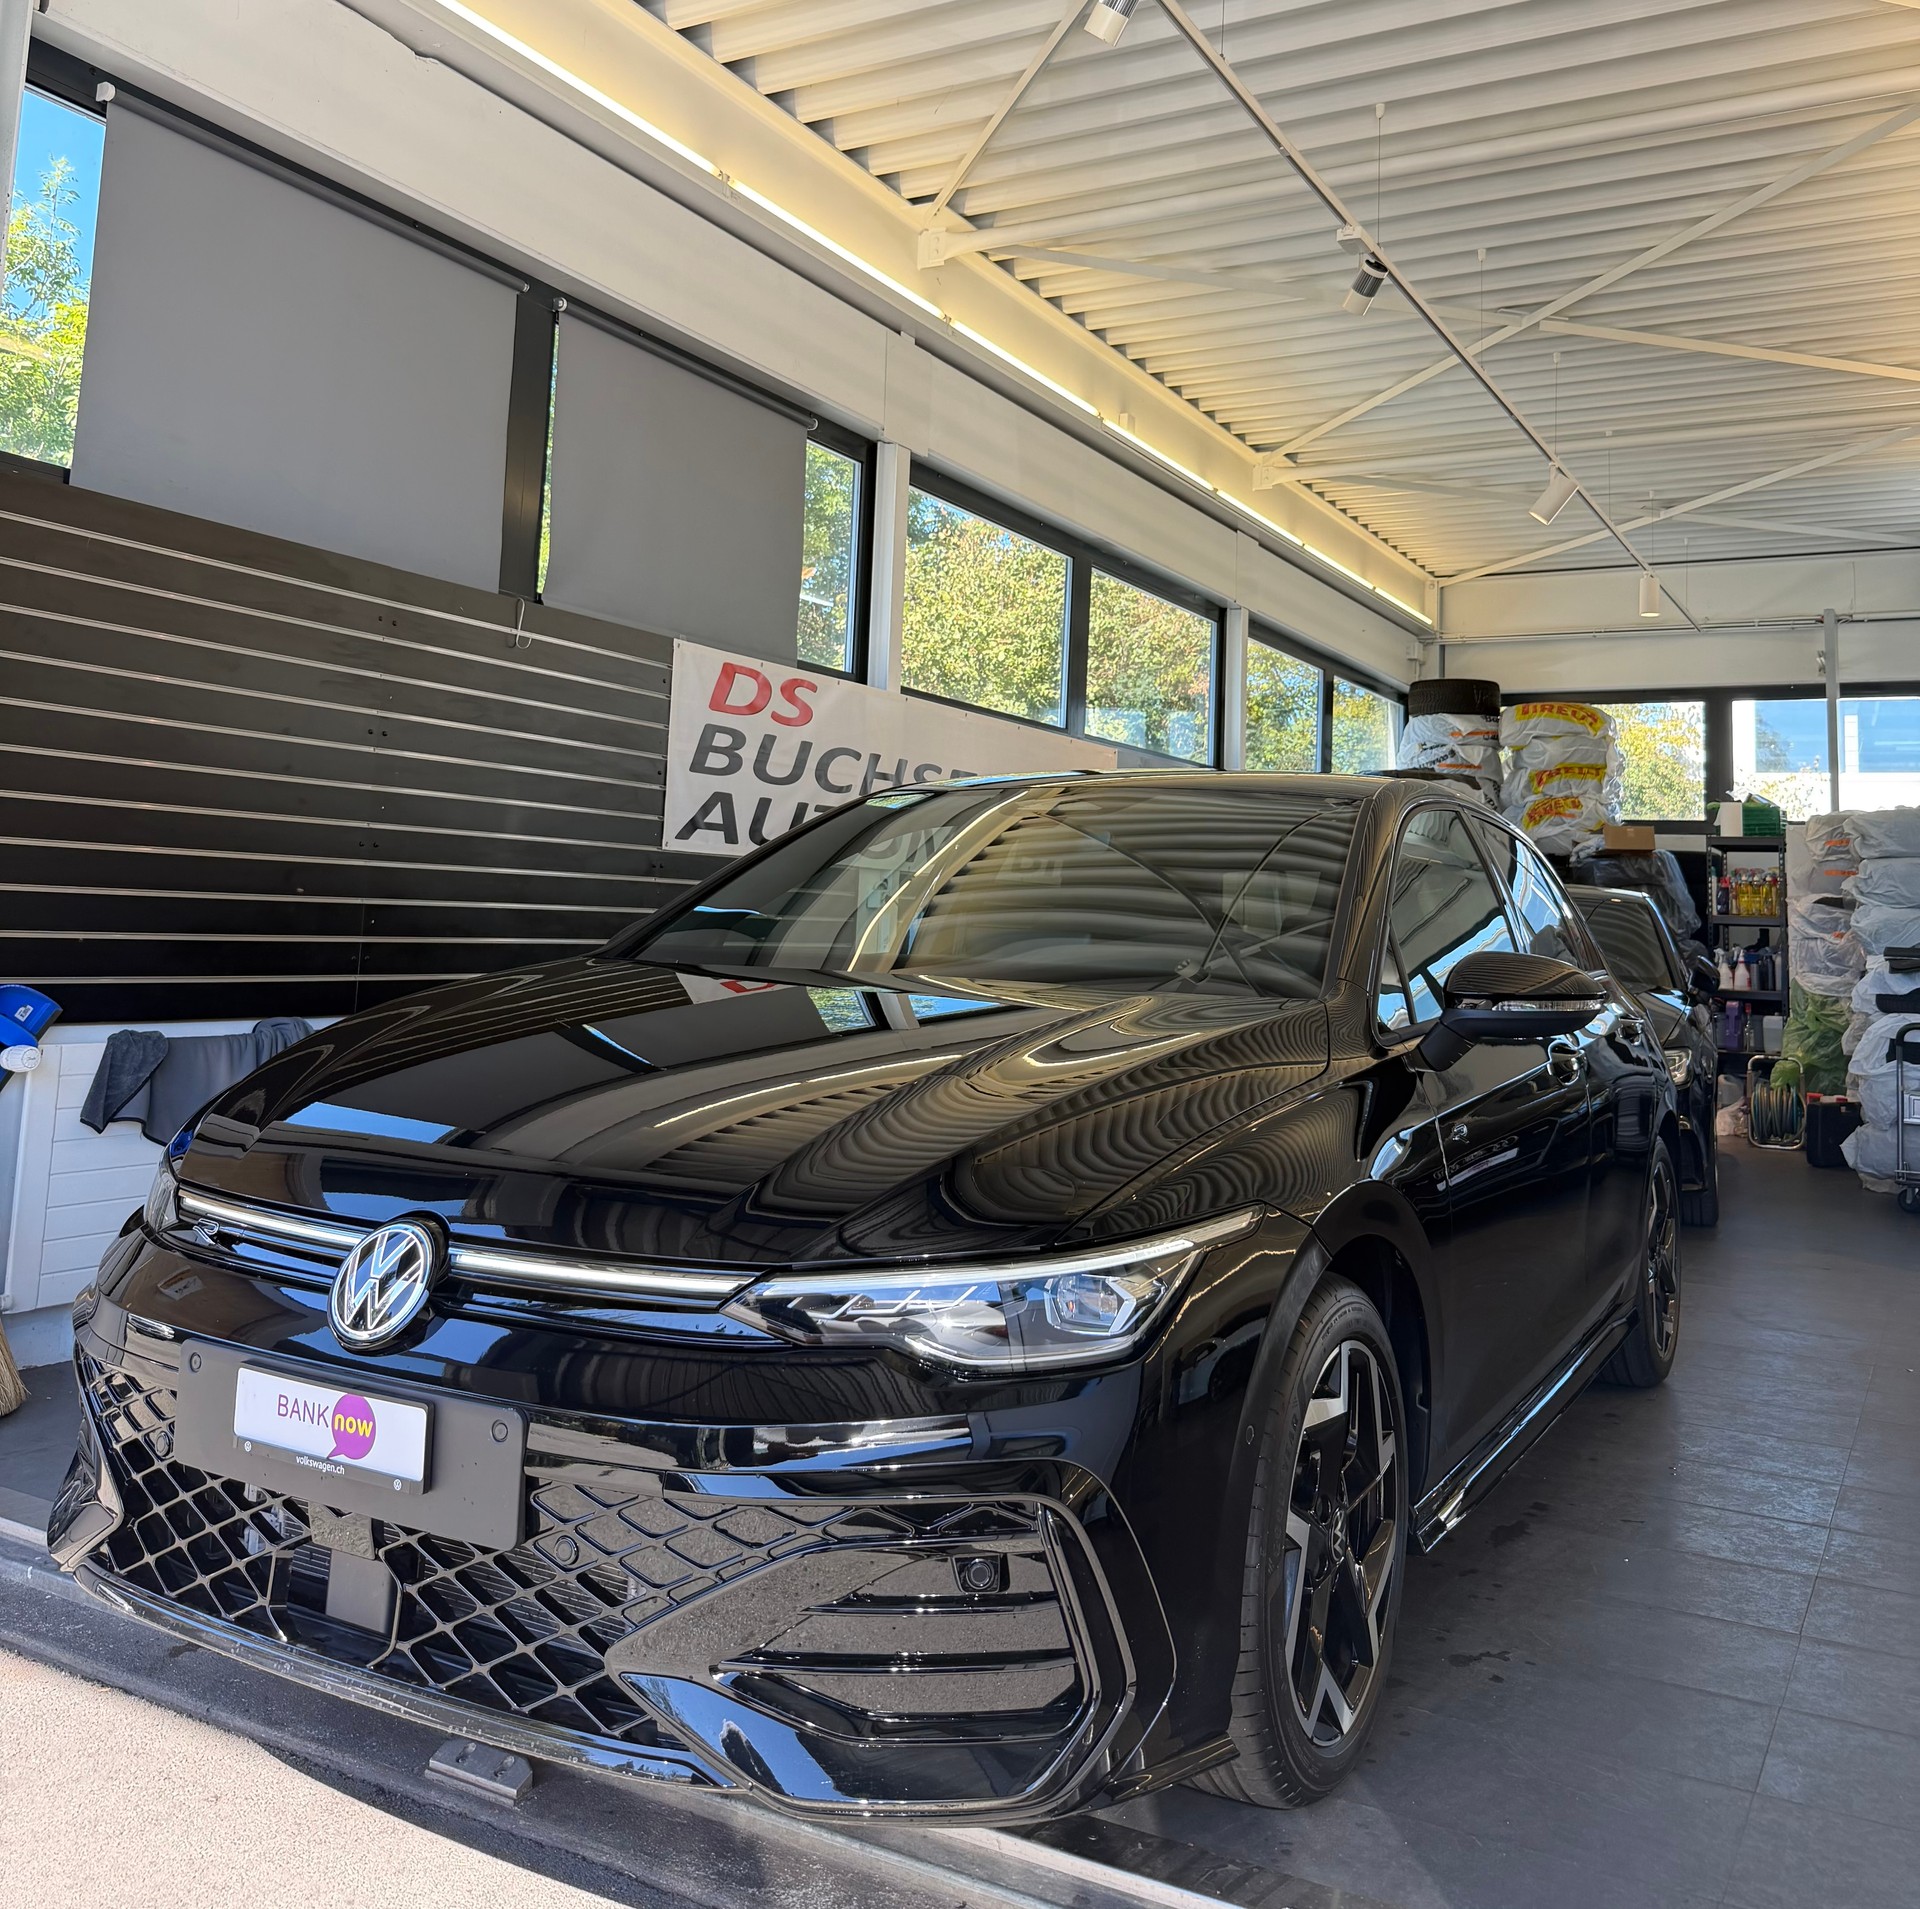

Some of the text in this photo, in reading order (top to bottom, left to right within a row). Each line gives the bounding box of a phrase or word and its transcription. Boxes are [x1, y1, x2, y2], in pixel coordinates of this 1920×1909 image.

[708, 661, 818, 728] DS
[689, 723, 978, 797] BUCHS
[674, 791, 838, 846] AU
[277, 1393, 373, 1438] BANK now
[296, 1455, 345, 1475] volkswagen.ch
